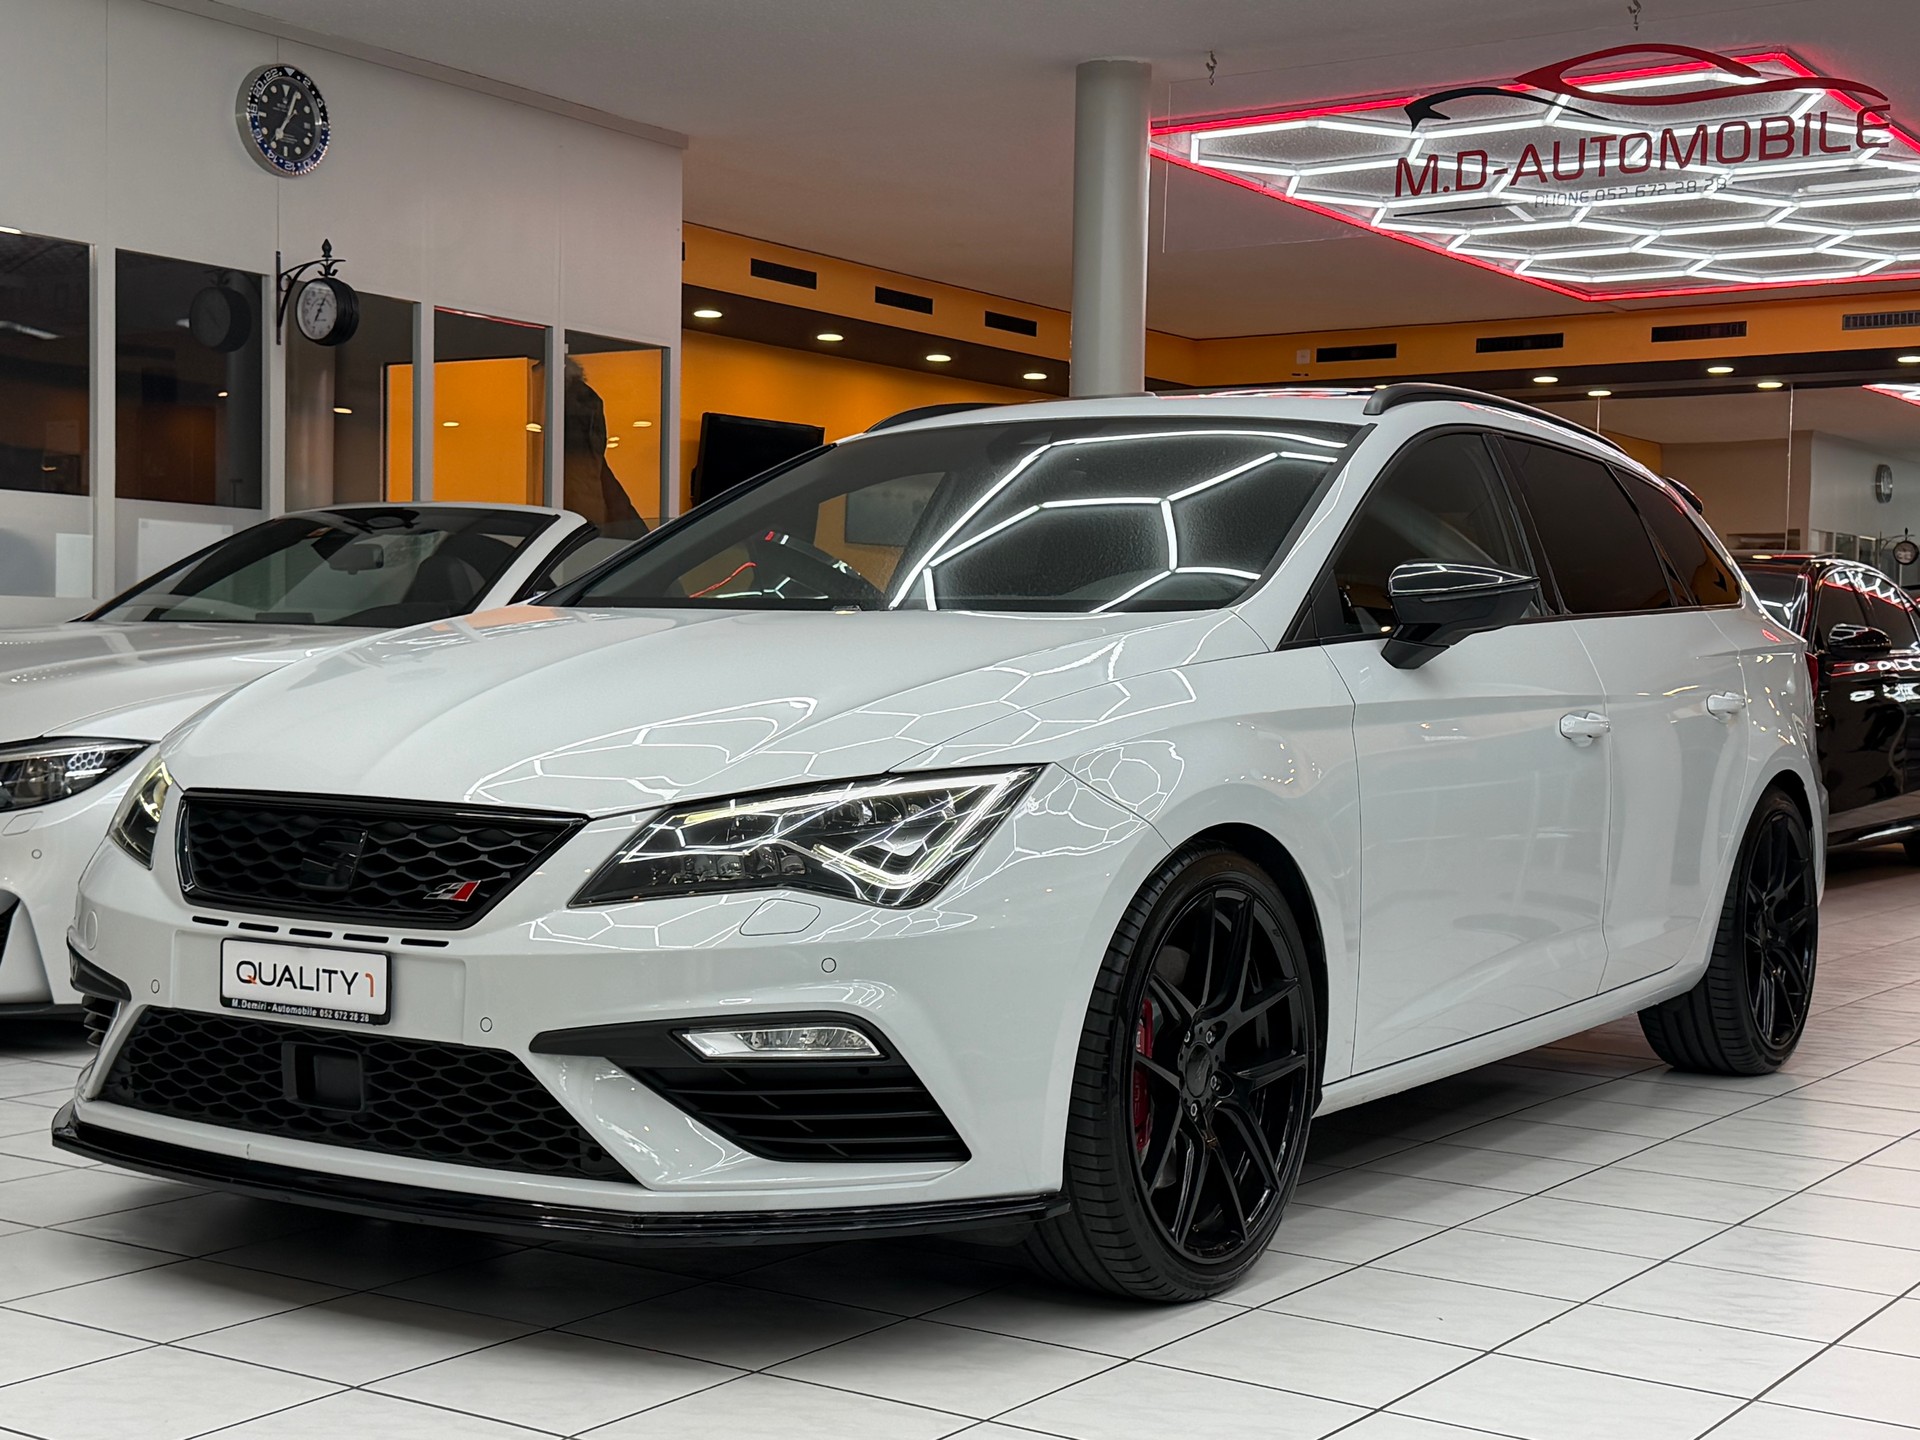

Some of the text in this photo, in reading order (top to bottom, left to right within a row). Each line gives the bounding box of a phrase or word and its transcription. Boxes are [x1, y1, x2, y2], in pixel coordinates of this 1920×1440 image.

[264, 68, 279, 81] 22
[253, 80, 265, 96] 20
[302, 77, 311, 88] 2
[249, 103, 259, 117] 18
[316, 98, 324, 108] 4
[267, 149, 278, 164] 14
[1394, 105, 1891, 197] M.D-AUTOMOBILE
[284, 160, 296, 171] 12
[1535, 177, 1727, 208] PHONE 052 672 28 28
[236, 960, 375, 998] QUALITY 1
[272, 1003, 317, 1017] Automobile
[319, 1009, 333, 1018] 052
[334, 1010, 348, 1020] 672
[349, 1012, 358, 1021] 28
[360, 1013, 369, 1023] 28
